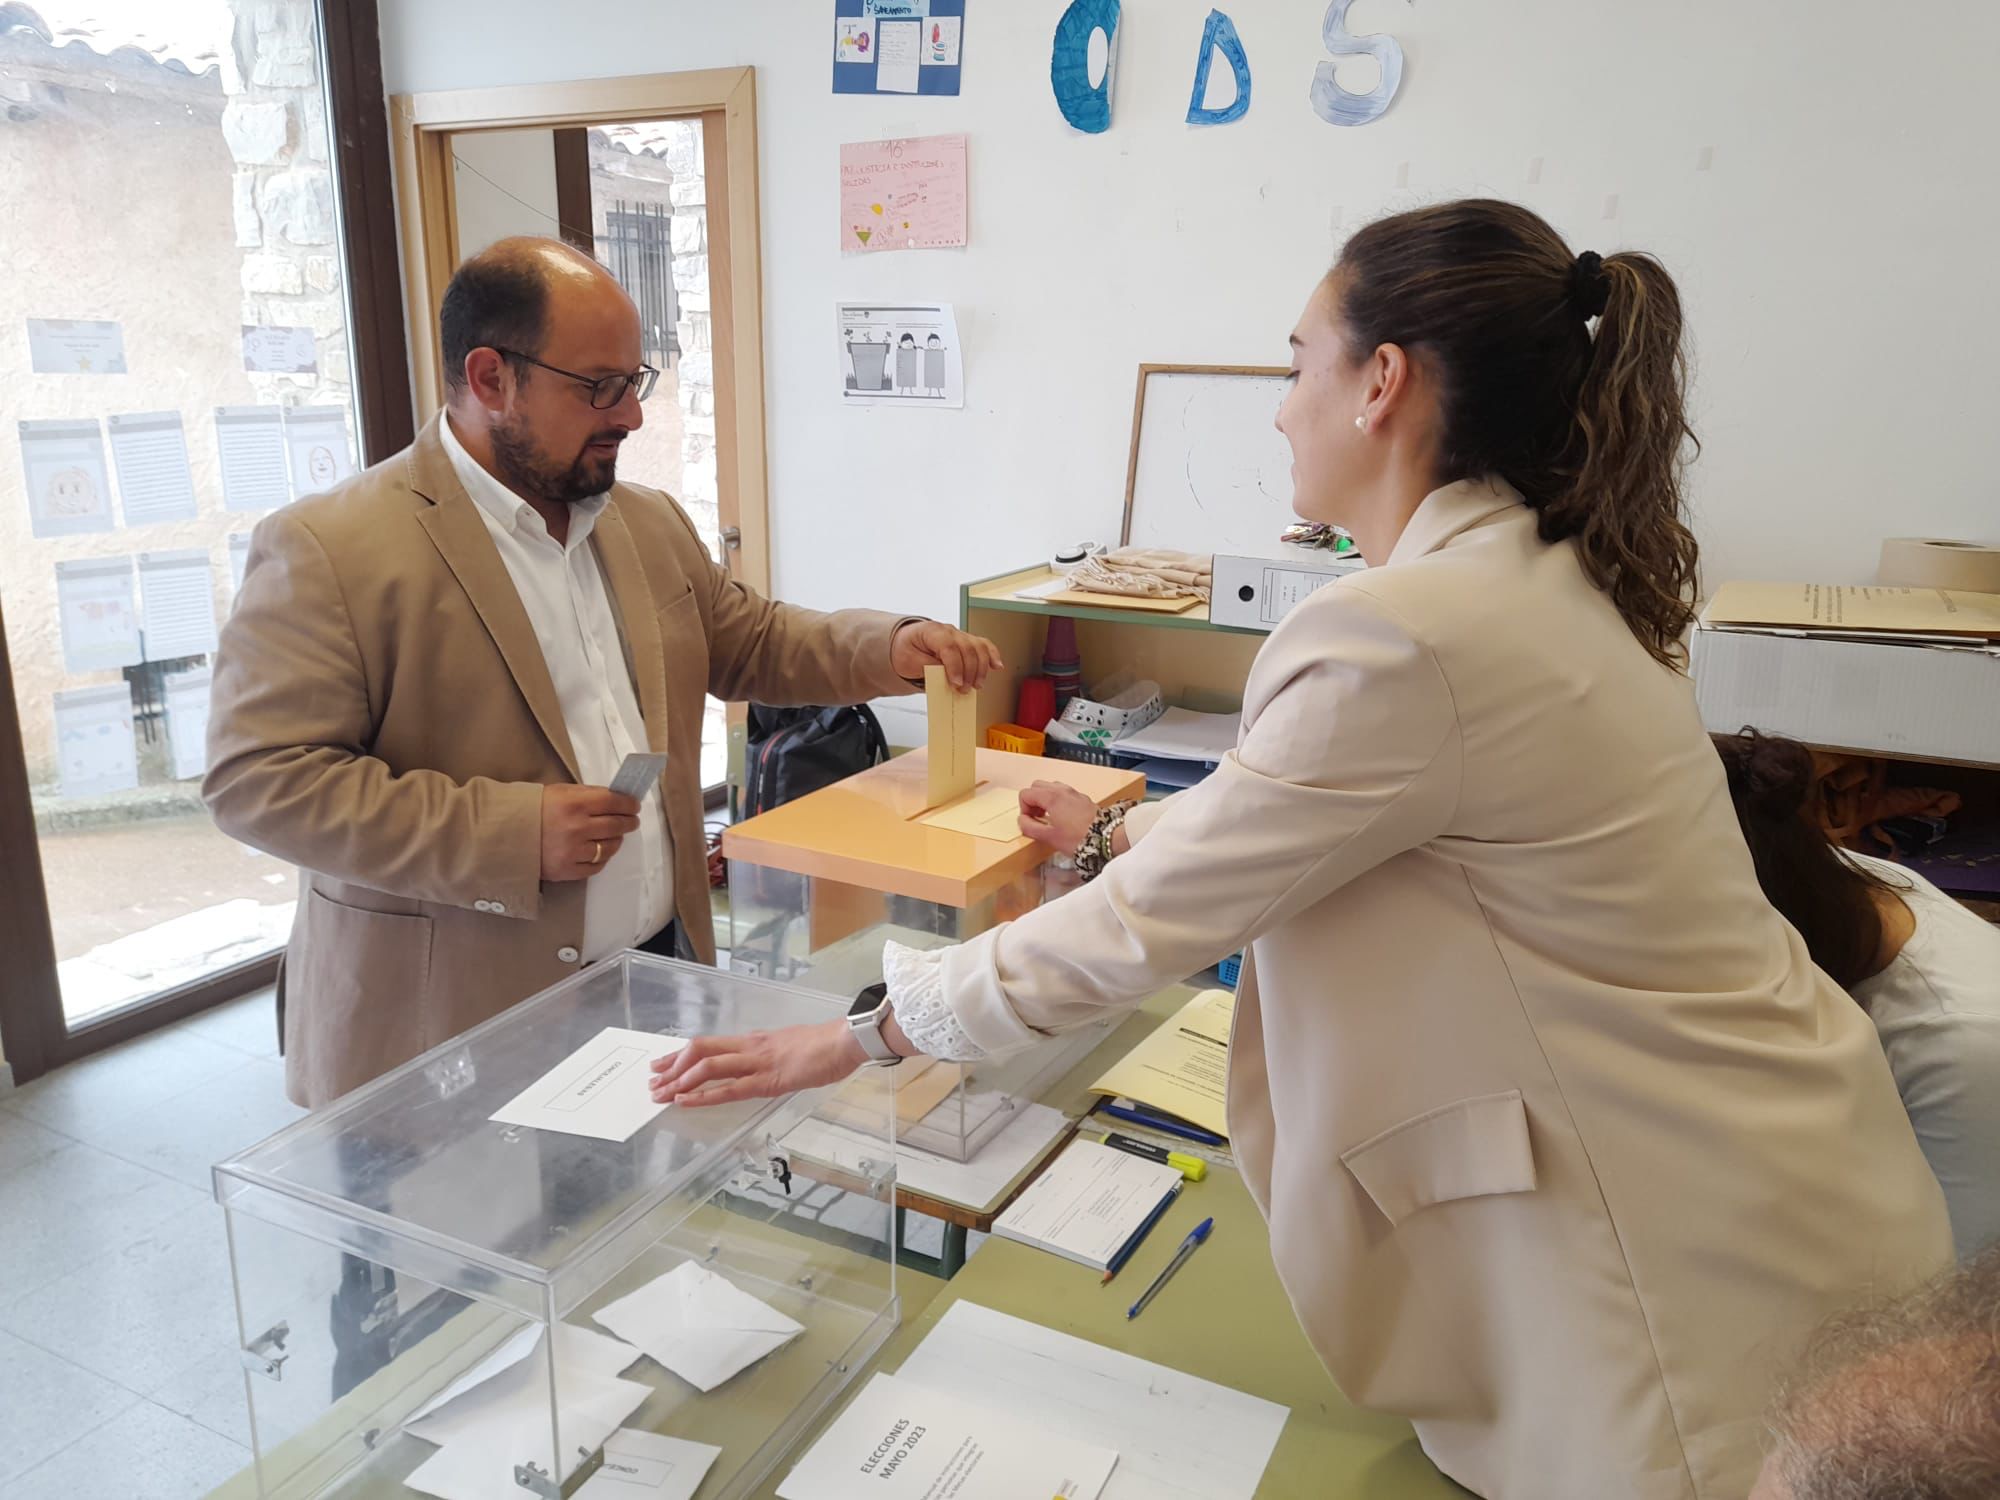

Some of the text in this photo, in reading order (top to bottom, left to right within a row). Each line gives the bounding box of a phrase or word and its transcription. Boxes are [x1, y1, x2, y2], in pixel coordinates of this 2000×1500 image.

[860, 1418, 910, 1474] ELECCIONES
[879, 1425, 927, 1479] MAYO 2023
